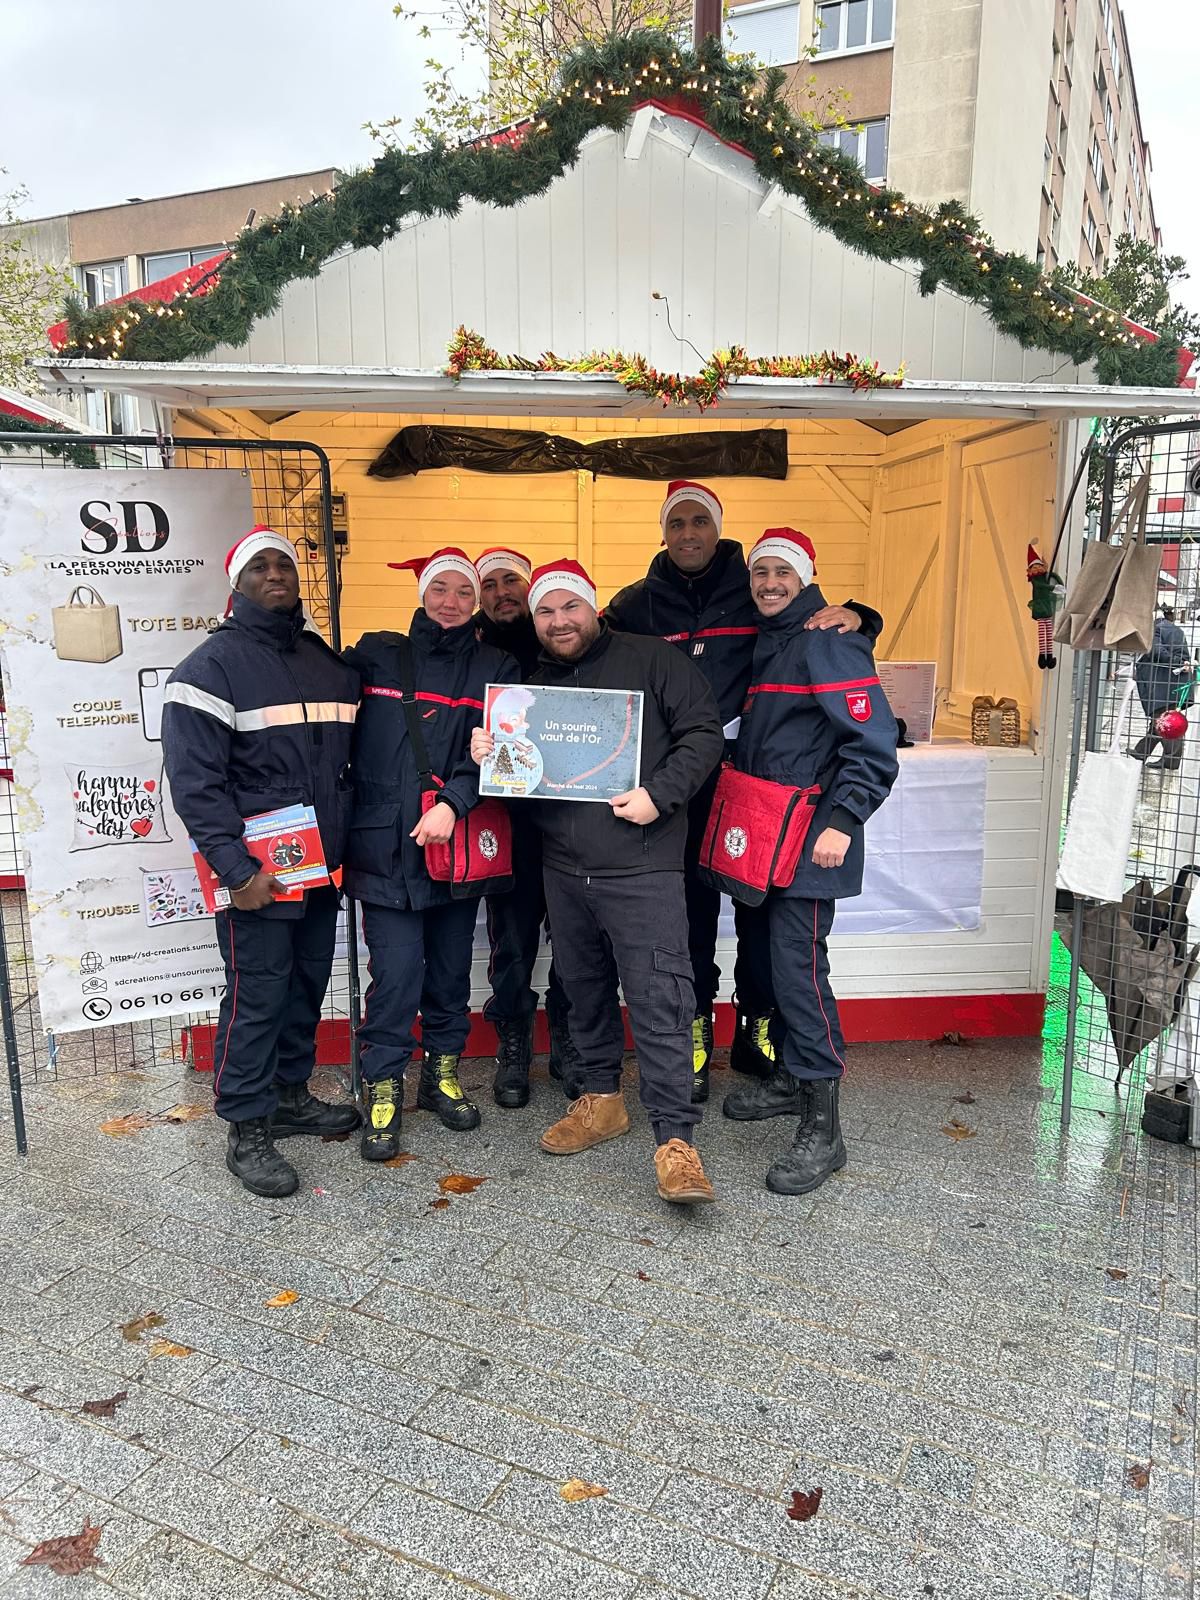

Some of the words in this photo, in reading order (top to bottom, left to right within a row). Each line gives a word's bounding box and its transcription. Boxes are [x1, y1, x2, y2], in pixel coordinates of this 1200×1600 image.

[79, 500, 170, 554] SD
[50, 561, 67, 569] LA
[71, 559, 205, 569] PERSONNALISATION
[65, 568, 110, 576] SELON
[113, 567, 141, 575] VOS
[146, 566, 192, 574] ENVIES
[128, 617, 178, 632] TOTE
[181, 616, 219, 630] BAG
[72, 700, 123, 713] COQUE
[56, 713, 140, 728] TELEPHONE
[545, 720, 560, 730] Un
[562, 722, 598, 732] sourire
[539, 732, 564, 742] vaut
[566, 732, 580, 743] de
[582, 733, 602, 744] l'Or
[77, 769, 147, 798] happy
[96, 812, 132, 839] day
[77, 903, 141, 920] TROUSSE
[120, 996, 146, 1010] 06
[152, 993, 173, 1005] 10
[180, 988, 204, 1002] 66
[209, 985, 227, 998] 17
